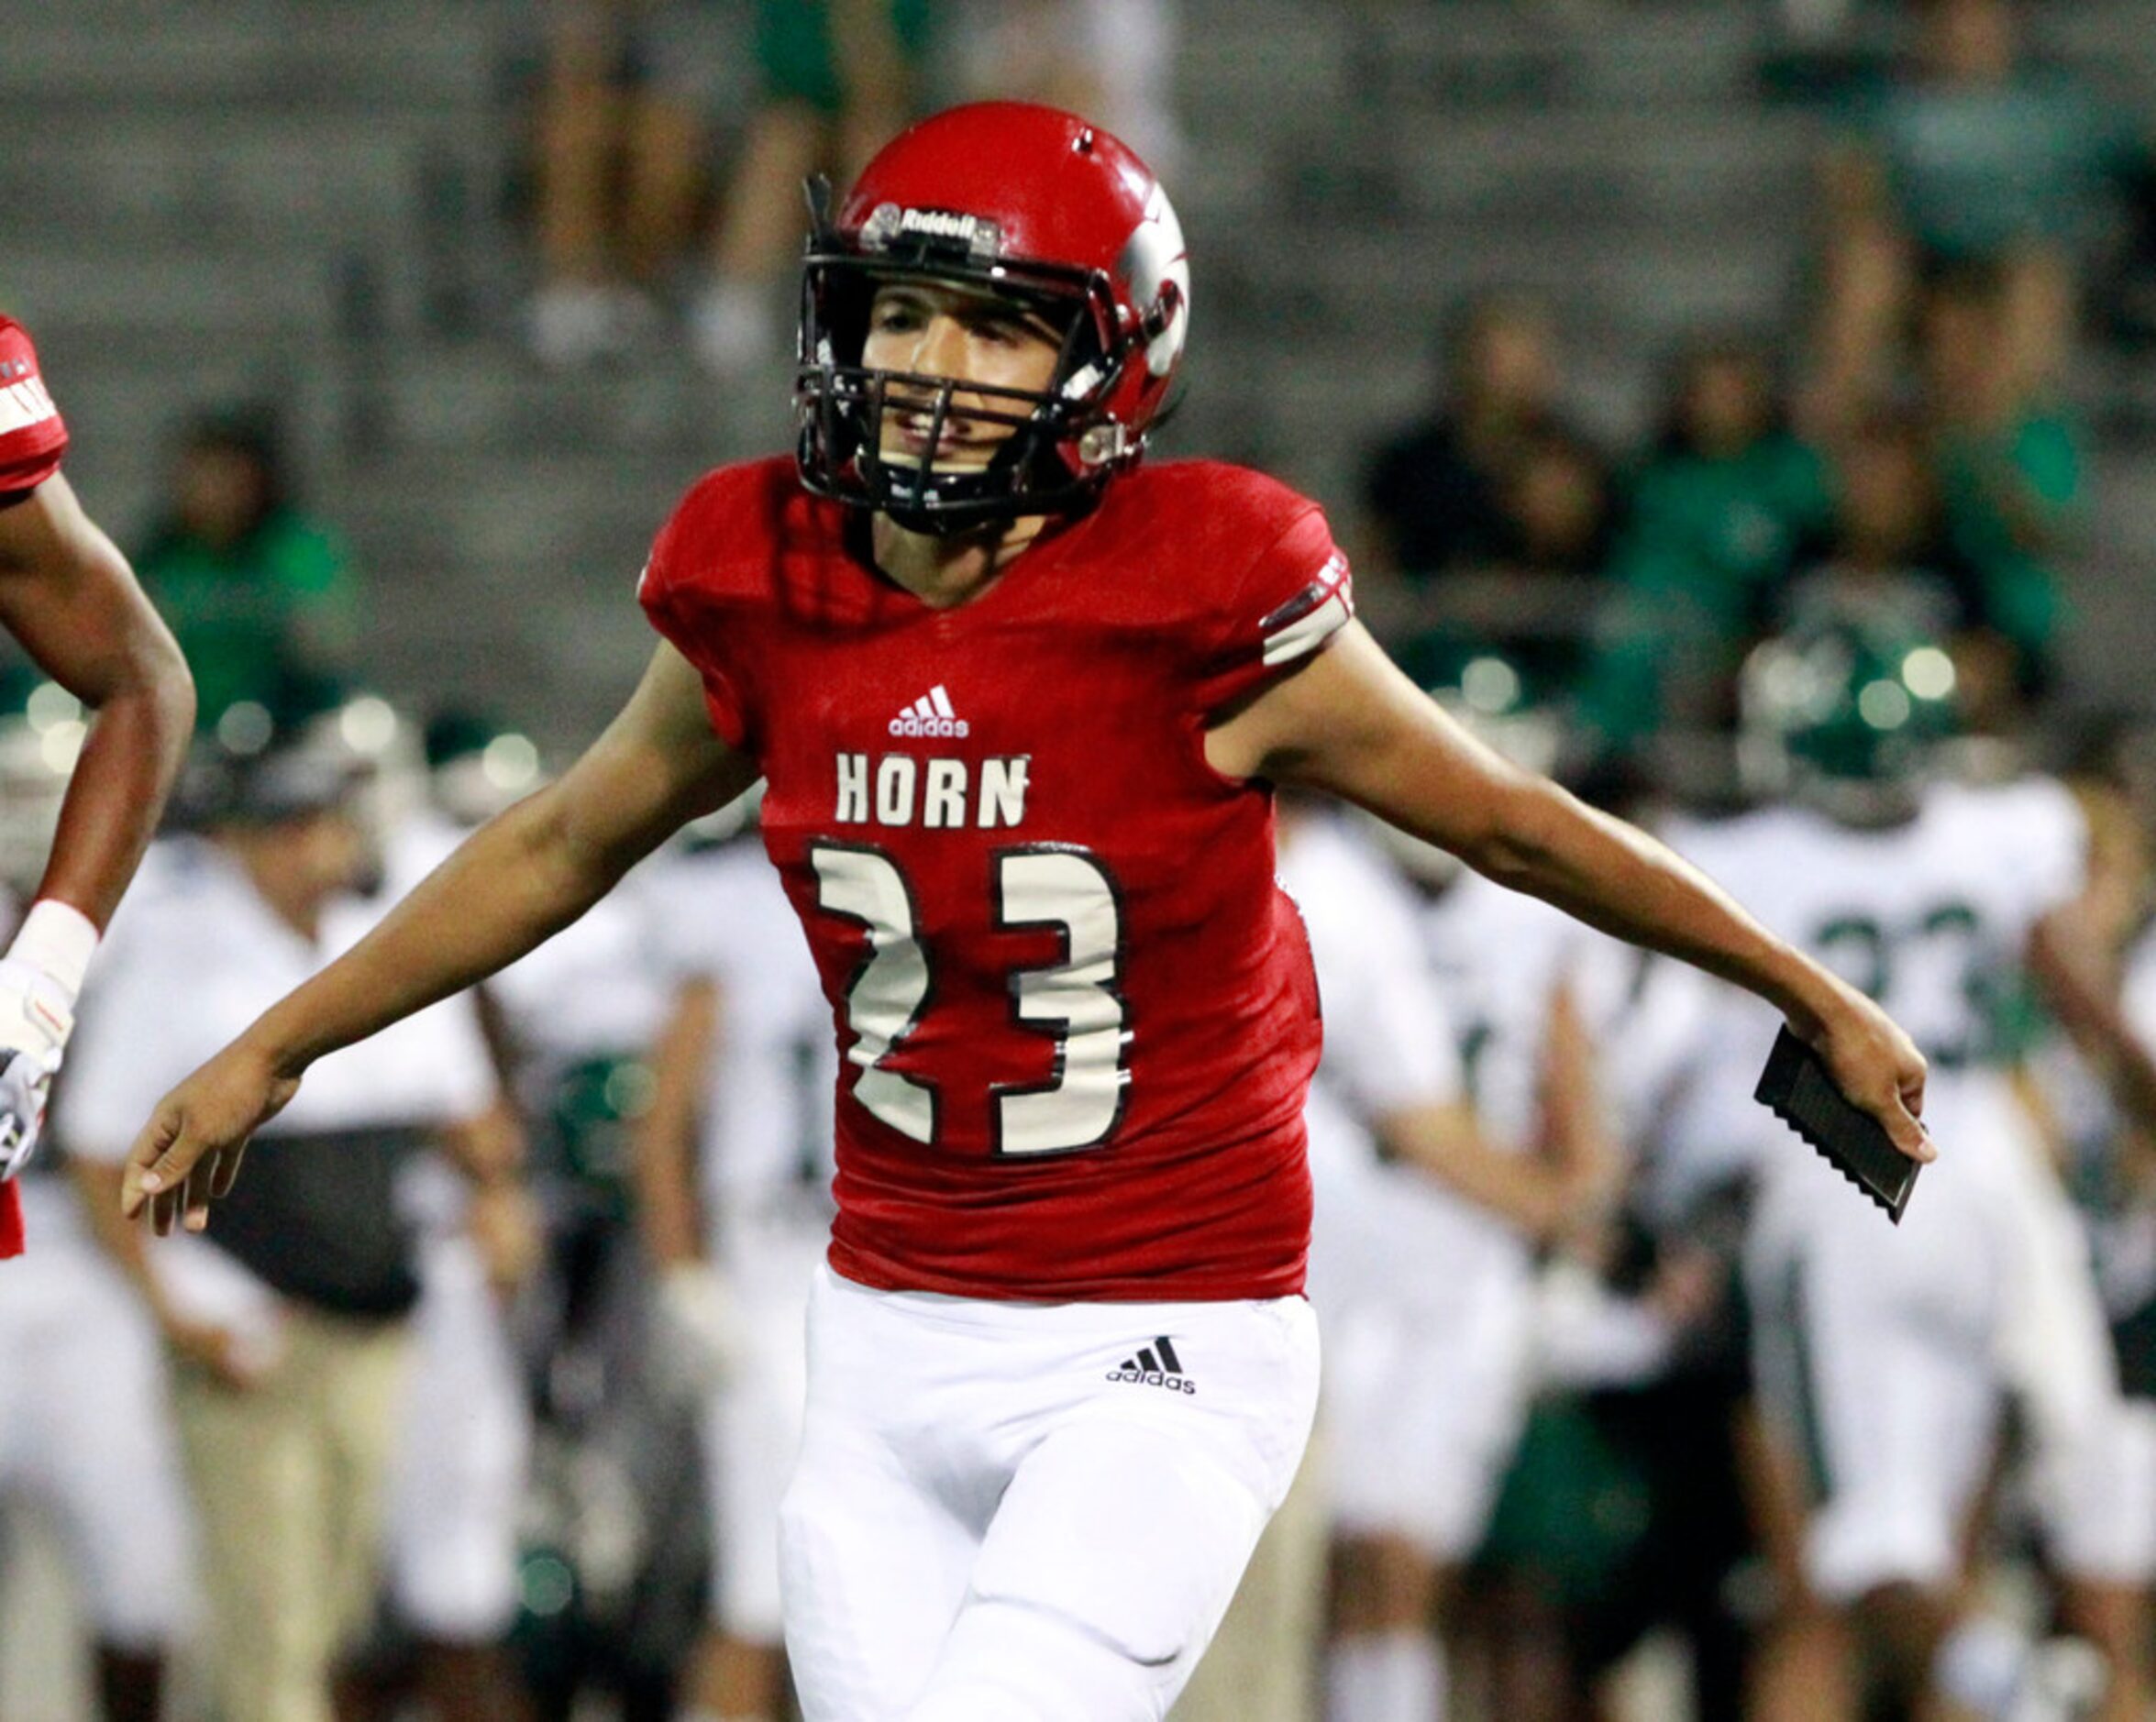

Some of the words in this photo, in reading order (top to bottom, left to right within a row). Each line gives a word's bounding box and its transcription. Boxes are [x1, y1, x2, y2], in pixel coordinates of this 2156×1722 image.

[901, 208, 977, 238] Riddell
[888, 717, 969, 737] adidas
[835, 753, 1029, 828] HORN
[809, 838, 1133, 1156] 23
[1106, 1370, 1196, 1395] adidas
